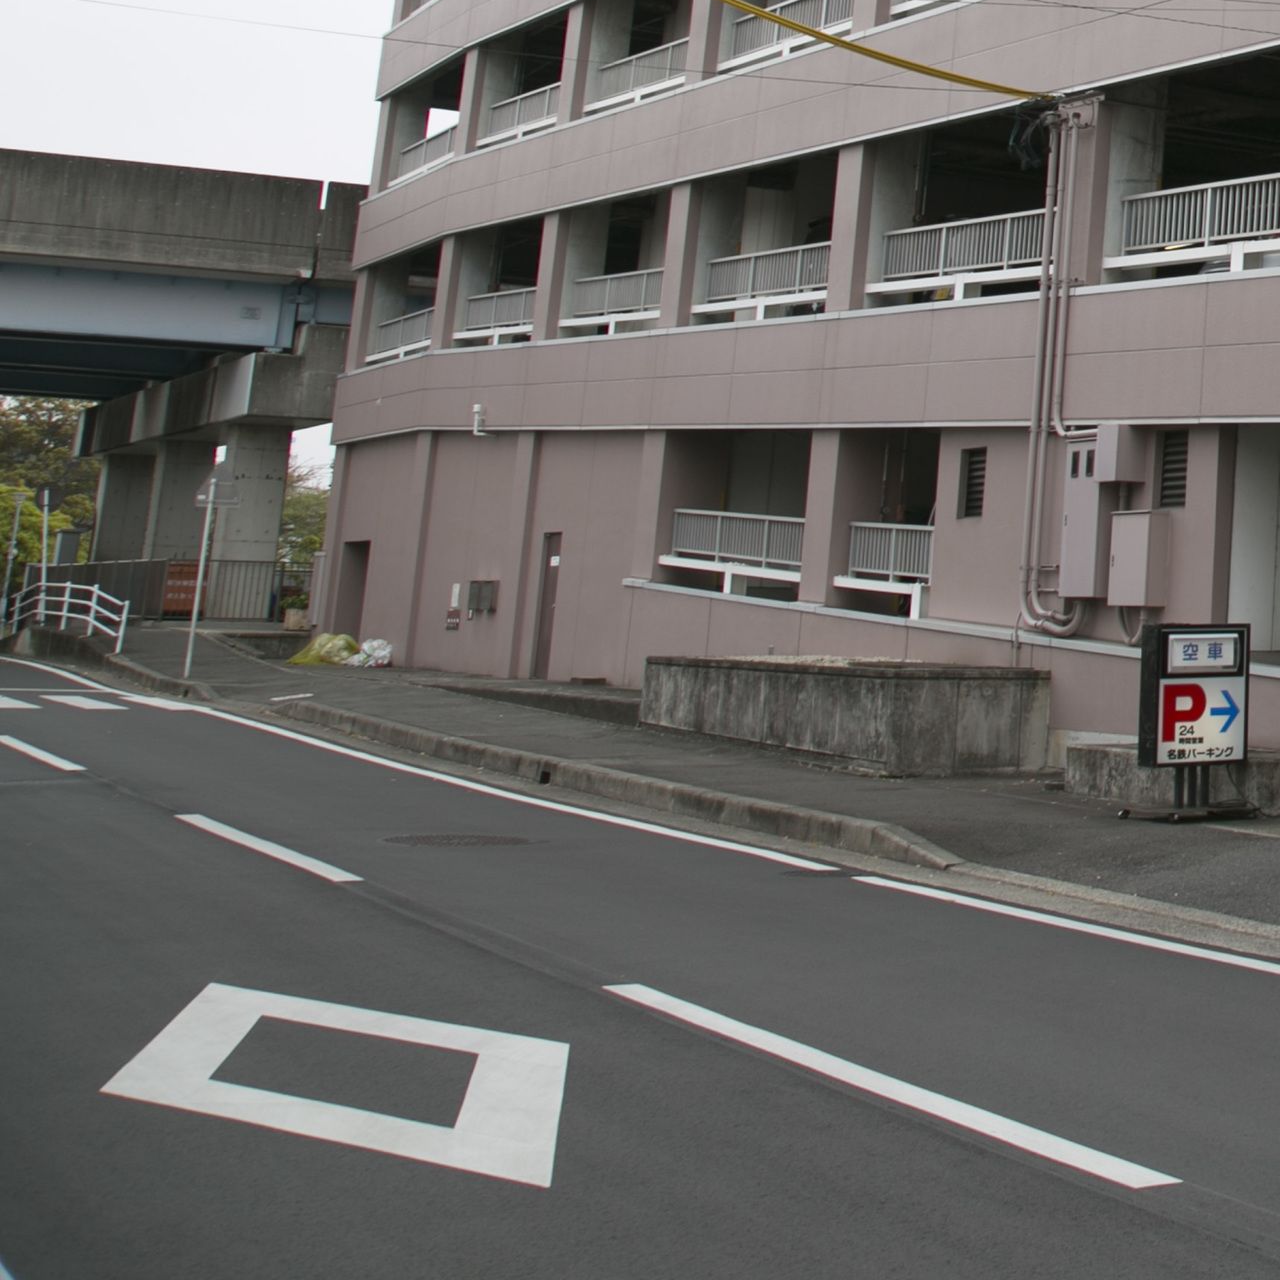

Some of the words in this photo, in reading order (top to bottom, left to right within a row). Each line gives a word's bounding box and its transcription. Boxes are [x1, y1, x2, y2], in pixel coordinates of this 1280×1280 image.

[1182, 642, 1223, 661] 空車
[1162, 683, 1207, 743] P
[1179, 725, 1195, 736] 24
[1167, 747, 1234, 759] 名鉄パーキング
